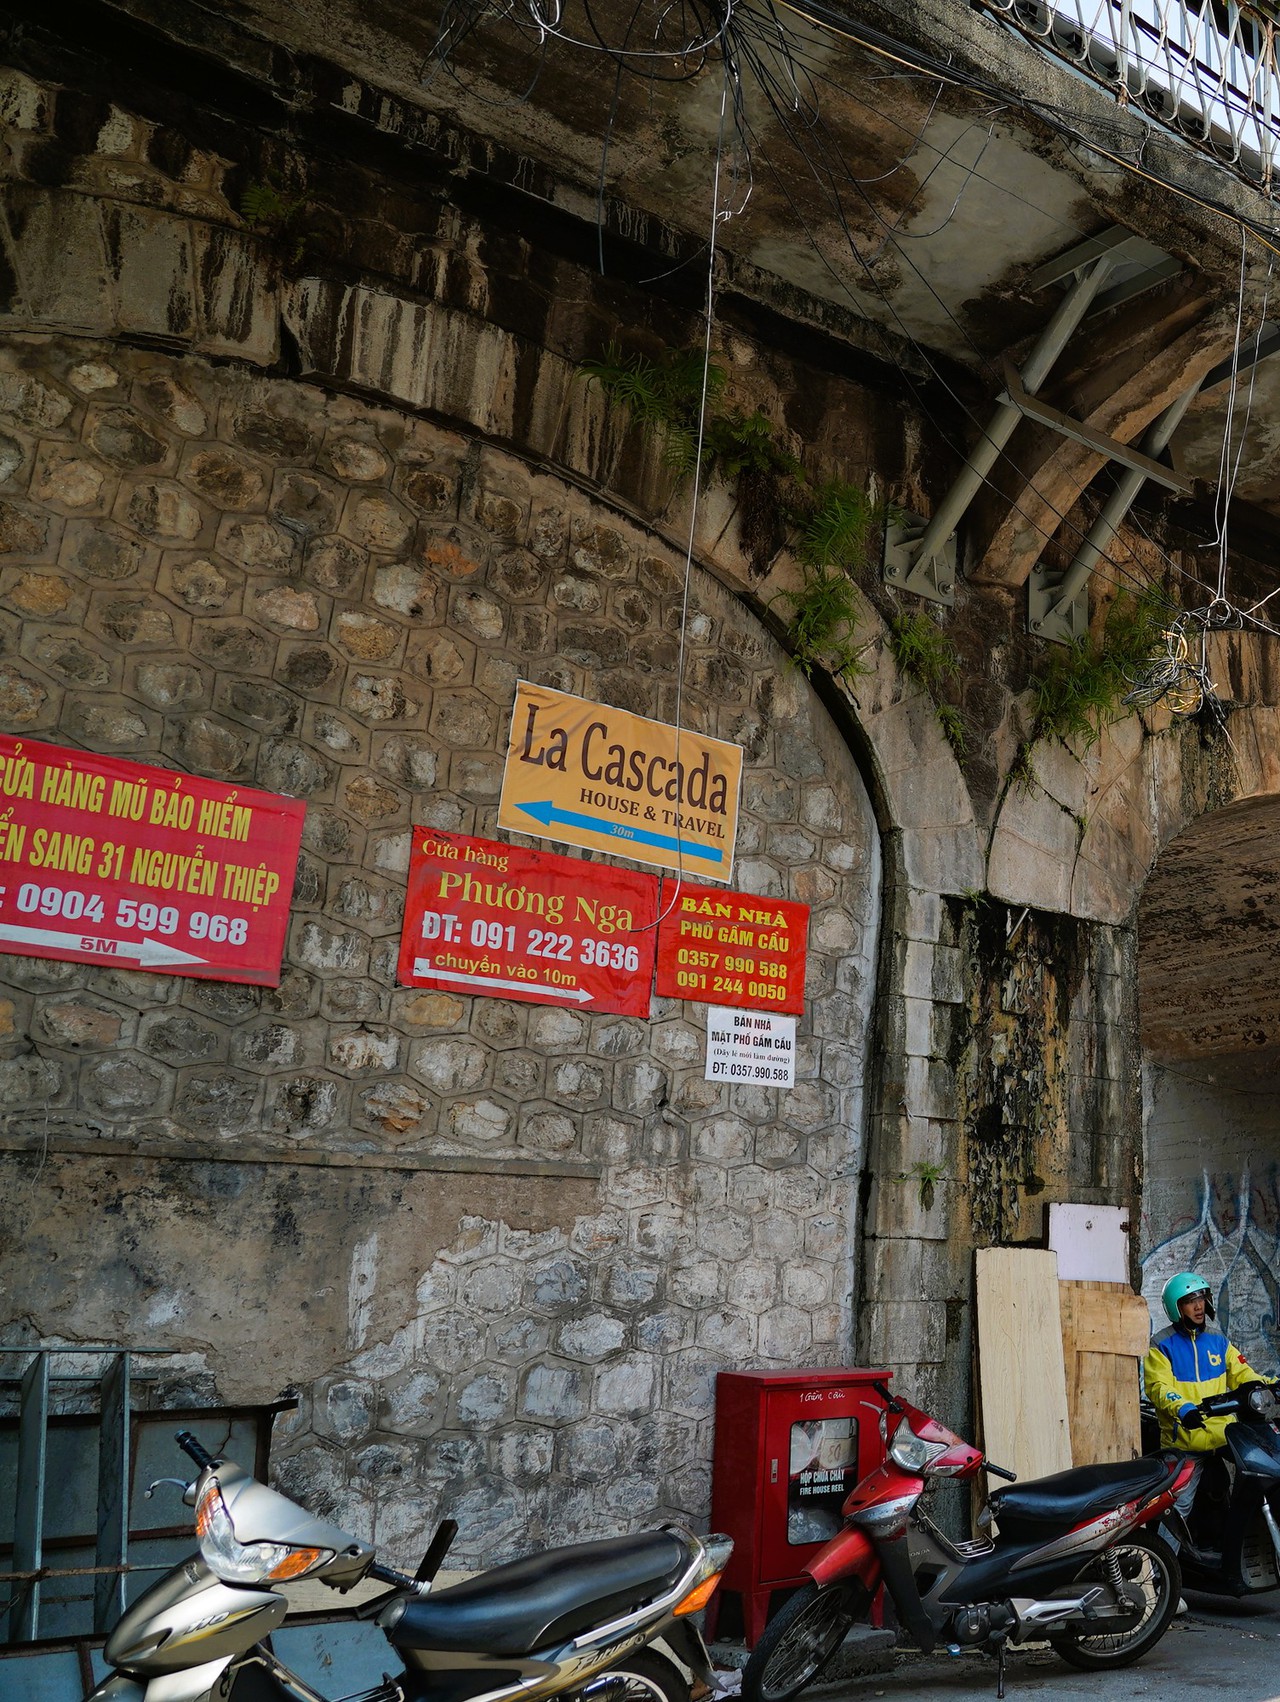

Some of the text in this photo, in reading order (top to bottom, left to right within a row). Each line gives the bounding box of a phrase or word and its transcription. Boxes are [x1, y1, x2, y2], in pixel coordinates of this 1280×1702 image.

[520, 703, 728, 816] La Cascada
[41, 762, 105, 813] HÀNG
[109, 778, 148, 821] MŨ
[149, 777, 195, 831] BẢO
[198, 791, 253, 842] HIỂM
[580, 787, 725, 839] HOUSE & TRAVEL
[609, 824, 635, 839] 30m
[29, 828, 95, 875] SANG
[98, 842, 125, 880] 31
[130, 844, 219, 897] NGUYỄN
[223, 863, 280, 912] THIỆP
[464, 845, 509, 873] hàng
[17, 883, 105, 923] 0904
[116, 899, 180, 935] 599
[189, 911, 249, 946] 968
[437, 871, 634, 934] Phương Nga
[681, 897, 789, 929] BÁN NHÀ
[421, 911, 640, 972] ĐT: 091 222 3636
[680, 919, 714, 940] PHỐ
[80, 937, 118, 955] 5M
[435, 952, 577, 986] chuyển vào 10m
[677, 948, 788, 980] 0357 990 588
[677, 970, 787, 1001] 091 244 0050
[734, 1015, 752, 1028] BÁN
[712, 1061, 789, 1081] ĐT: 0357.990.588
[800, 1468, 845, 1487] HỘP CHỮA CHÁY
[800, 1484, 845, 1495] FIRE HOUSE REEL
